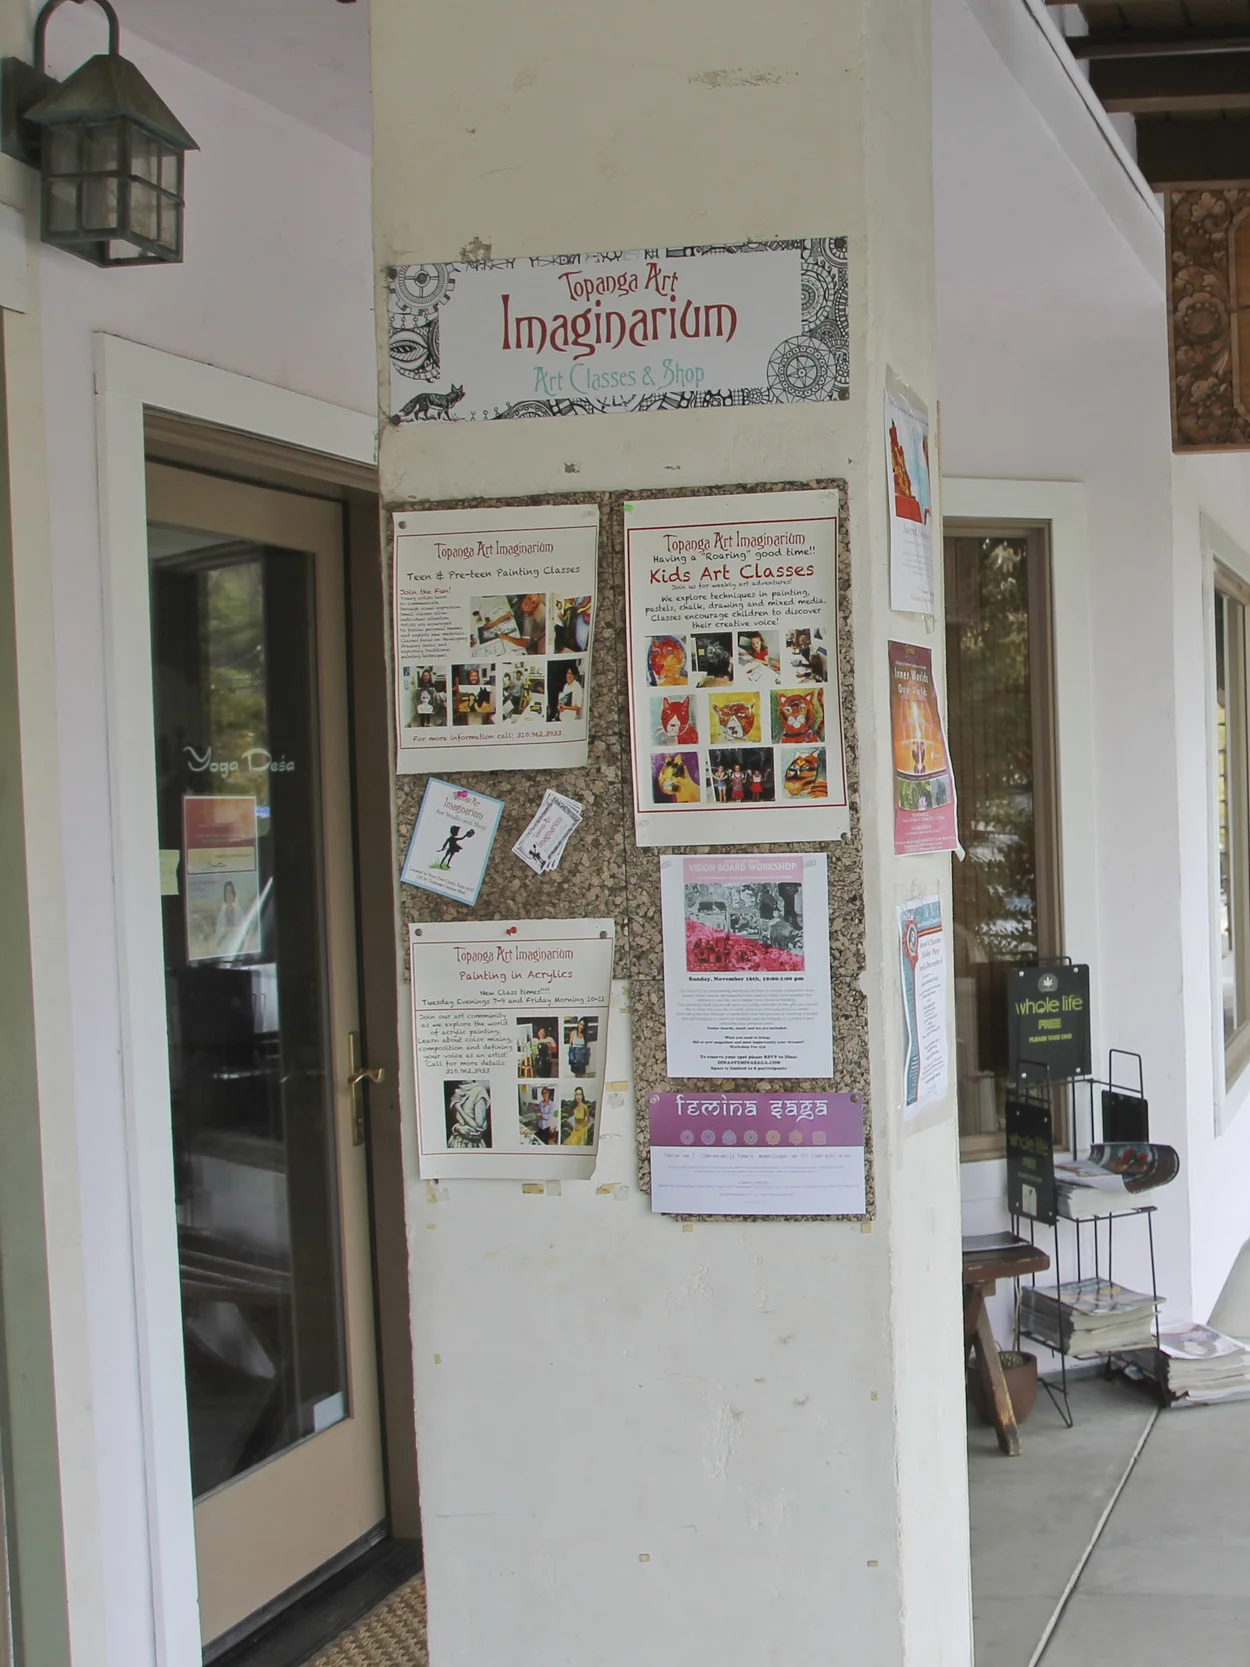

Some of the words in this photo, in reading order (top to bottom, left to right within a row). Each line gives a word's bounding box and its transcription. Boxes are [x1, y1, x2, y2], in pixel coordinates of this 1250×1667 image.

[558, 270, 639, 302] Topanga
[643, 262, 679, 297] Art
[501, 294, 738, 360] Imaginarium
[533, 365, 564, 397] Art
[570, 362, 637, 395] Classes
[641, 365, 658, 385] &
[662, 358, 705, 389] Shop
[434, 542, 475, 560] Topanga
[476, 541, 494, 559] Art
[496, 540, 554, 558] Imaginarium
[663, 534, 711, 554] Topanga
[713, 531, 733, 551] Art
[736, 531, 805, 550] Imaginarium
[653, 555, 687, 565] Having
[755, 549, 782, 560] good
[786, 546, 816, 556] time!!
[406, 572, 432, 582] Teen
[436, 571, 445, 580] &
[449, 570, 492, 580] Pre-teen
[496, 567, 540, 579] Painting
[543, 565, 581, 575] Classes
[650, 566, 691, 585] Kids
[700, 564, 730, 581] Art
[740, 562, 814, 579] Classes
[699, 582, 710, 590] for
[712, 582, 736, 590] weekly
[661, 595, 673, 603] We
[676, 594, 708, 604] explore
[710, 591, 756, 602] techniques
[645, 604, 677, 616] pastels,
[679, 603, 705, 611] chalk,
[708, 601, 744, 610] drawing
[747, 599, 764, 608] and
[767, 598, 795, 606] mixed
[651, 614, 681, 622] Classes
[684, 612, 729, 620] encourage
[732, 609, 768, 618] children
[785, 607, 821, 615] discover
[692, 621, 712, 629] their
[715, 620, 750, 628] creative
[753, 618, 779, 626] voice!
[450, 732, 494, 742] information
[182, 746, 239, 778] Yoga
[688, 863, 715, 872] VISION
[717, 862, 746, 872] BOARD
[748, 862, 797, 872] WORKSHOP
[453, 946, 494, 964] Topanga
[496, 945, 513, 963] Art
[515, 945, 574, 962] Imaginarium
[459, 970, 507, 983] Painting
[511, 971, 522, 979] in
[527, 970, 573, 983] Acrylics
[421, 999, 455, 1008] Tuesday
[456, 998, 490, 1006] Evenings
[526, 996, 551, 1006] Friday
[554, 996, 585, 1005] Morning
[1015, 996, 1060, 1015] whole
[1062, 994, 1083, 1012] life
[467, 1012, 507, 1021] community
[1038, 1018, 1062, 1030] FREE
[445, 1021, 471, 1029] explore
[441, 1029, 467, 1038] acrylic
[418, 1045, 463, 1054] composition
[482, 1043, 513, 1052] defining
[675, 1093, 758, 1117] femina
[769, 1099, 828, 1123] saga
